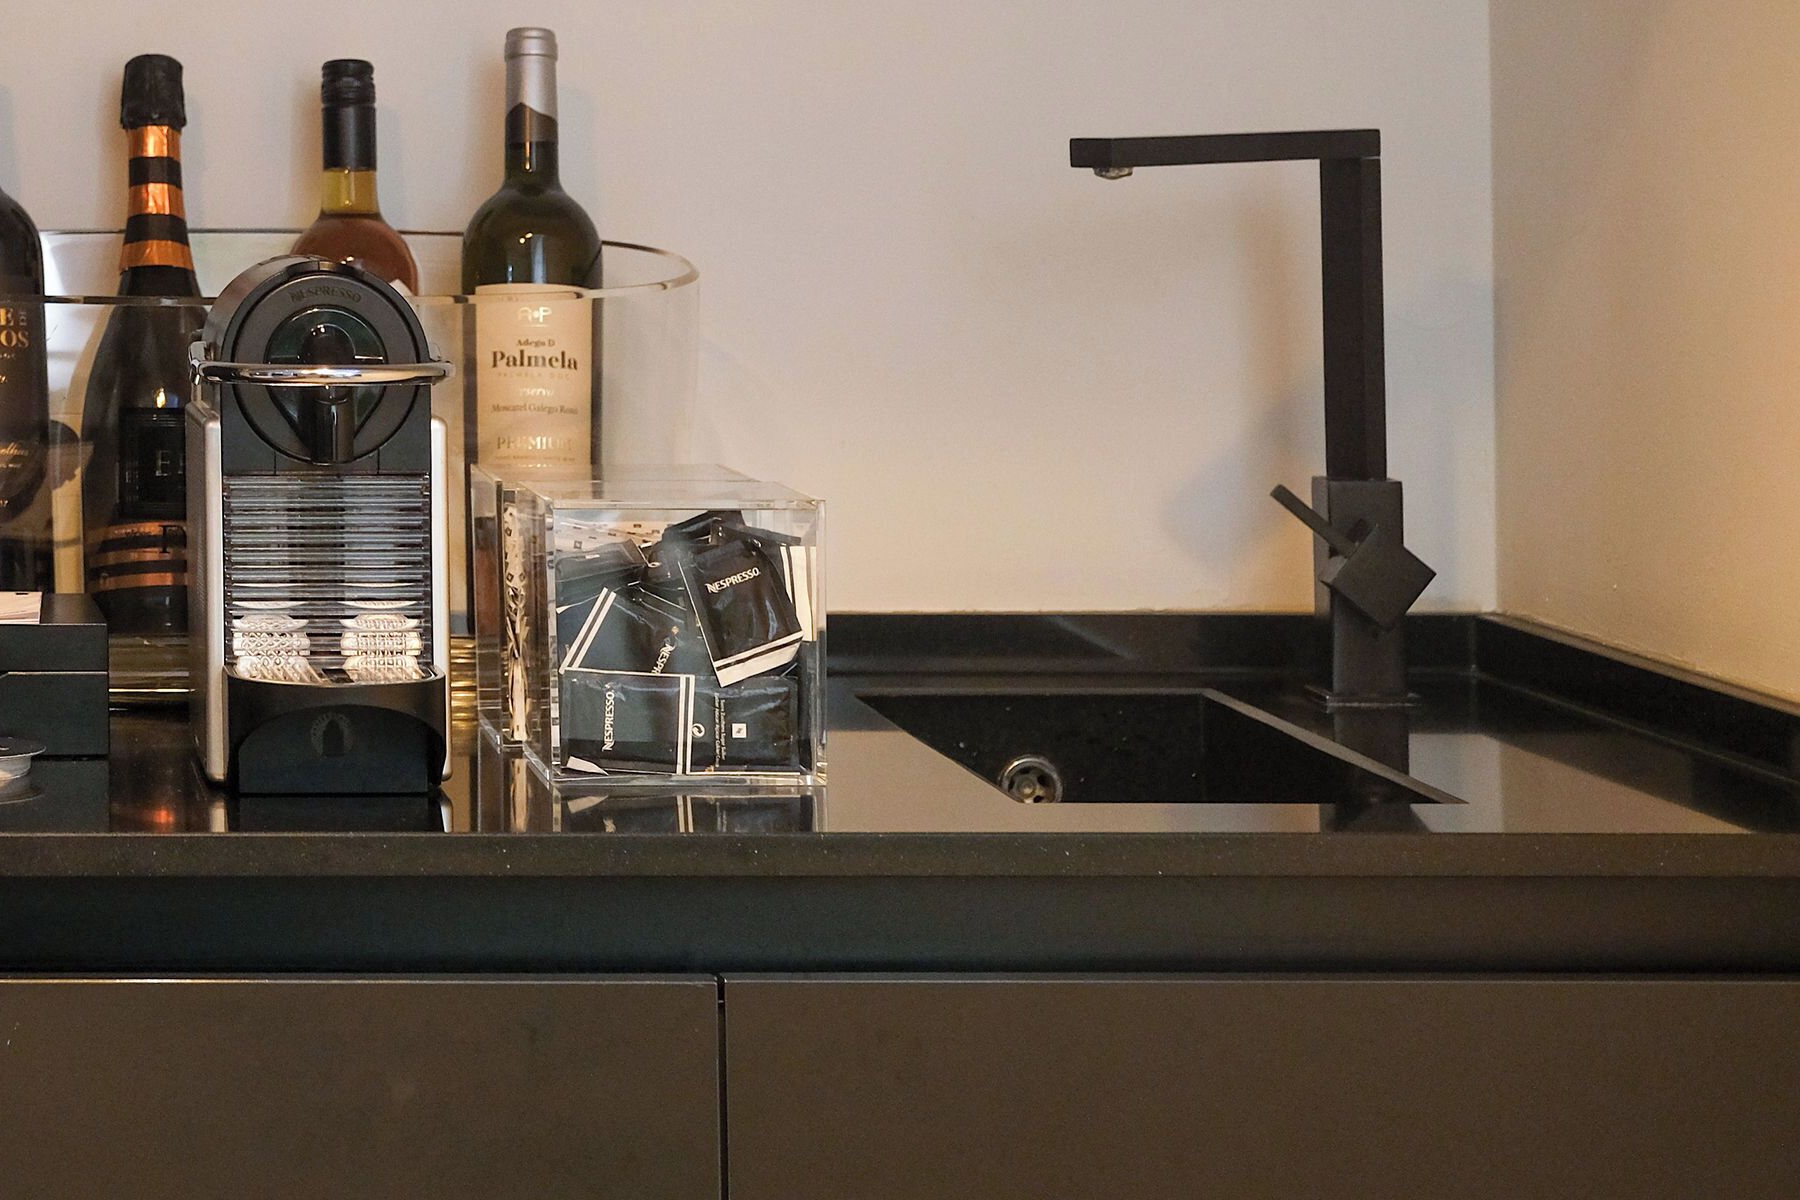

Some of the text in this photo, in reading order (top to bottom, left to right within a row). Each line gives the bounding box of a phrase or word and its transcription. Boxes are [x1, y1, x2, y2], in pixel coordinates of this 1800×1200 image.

[289, 285, 361, 303] NESPRESSO
[492, 350, 578, 370] Palmela
[705, 568, 761, 595] NESPRESSO
[601, 691, 615, 752] NESPRESSO
